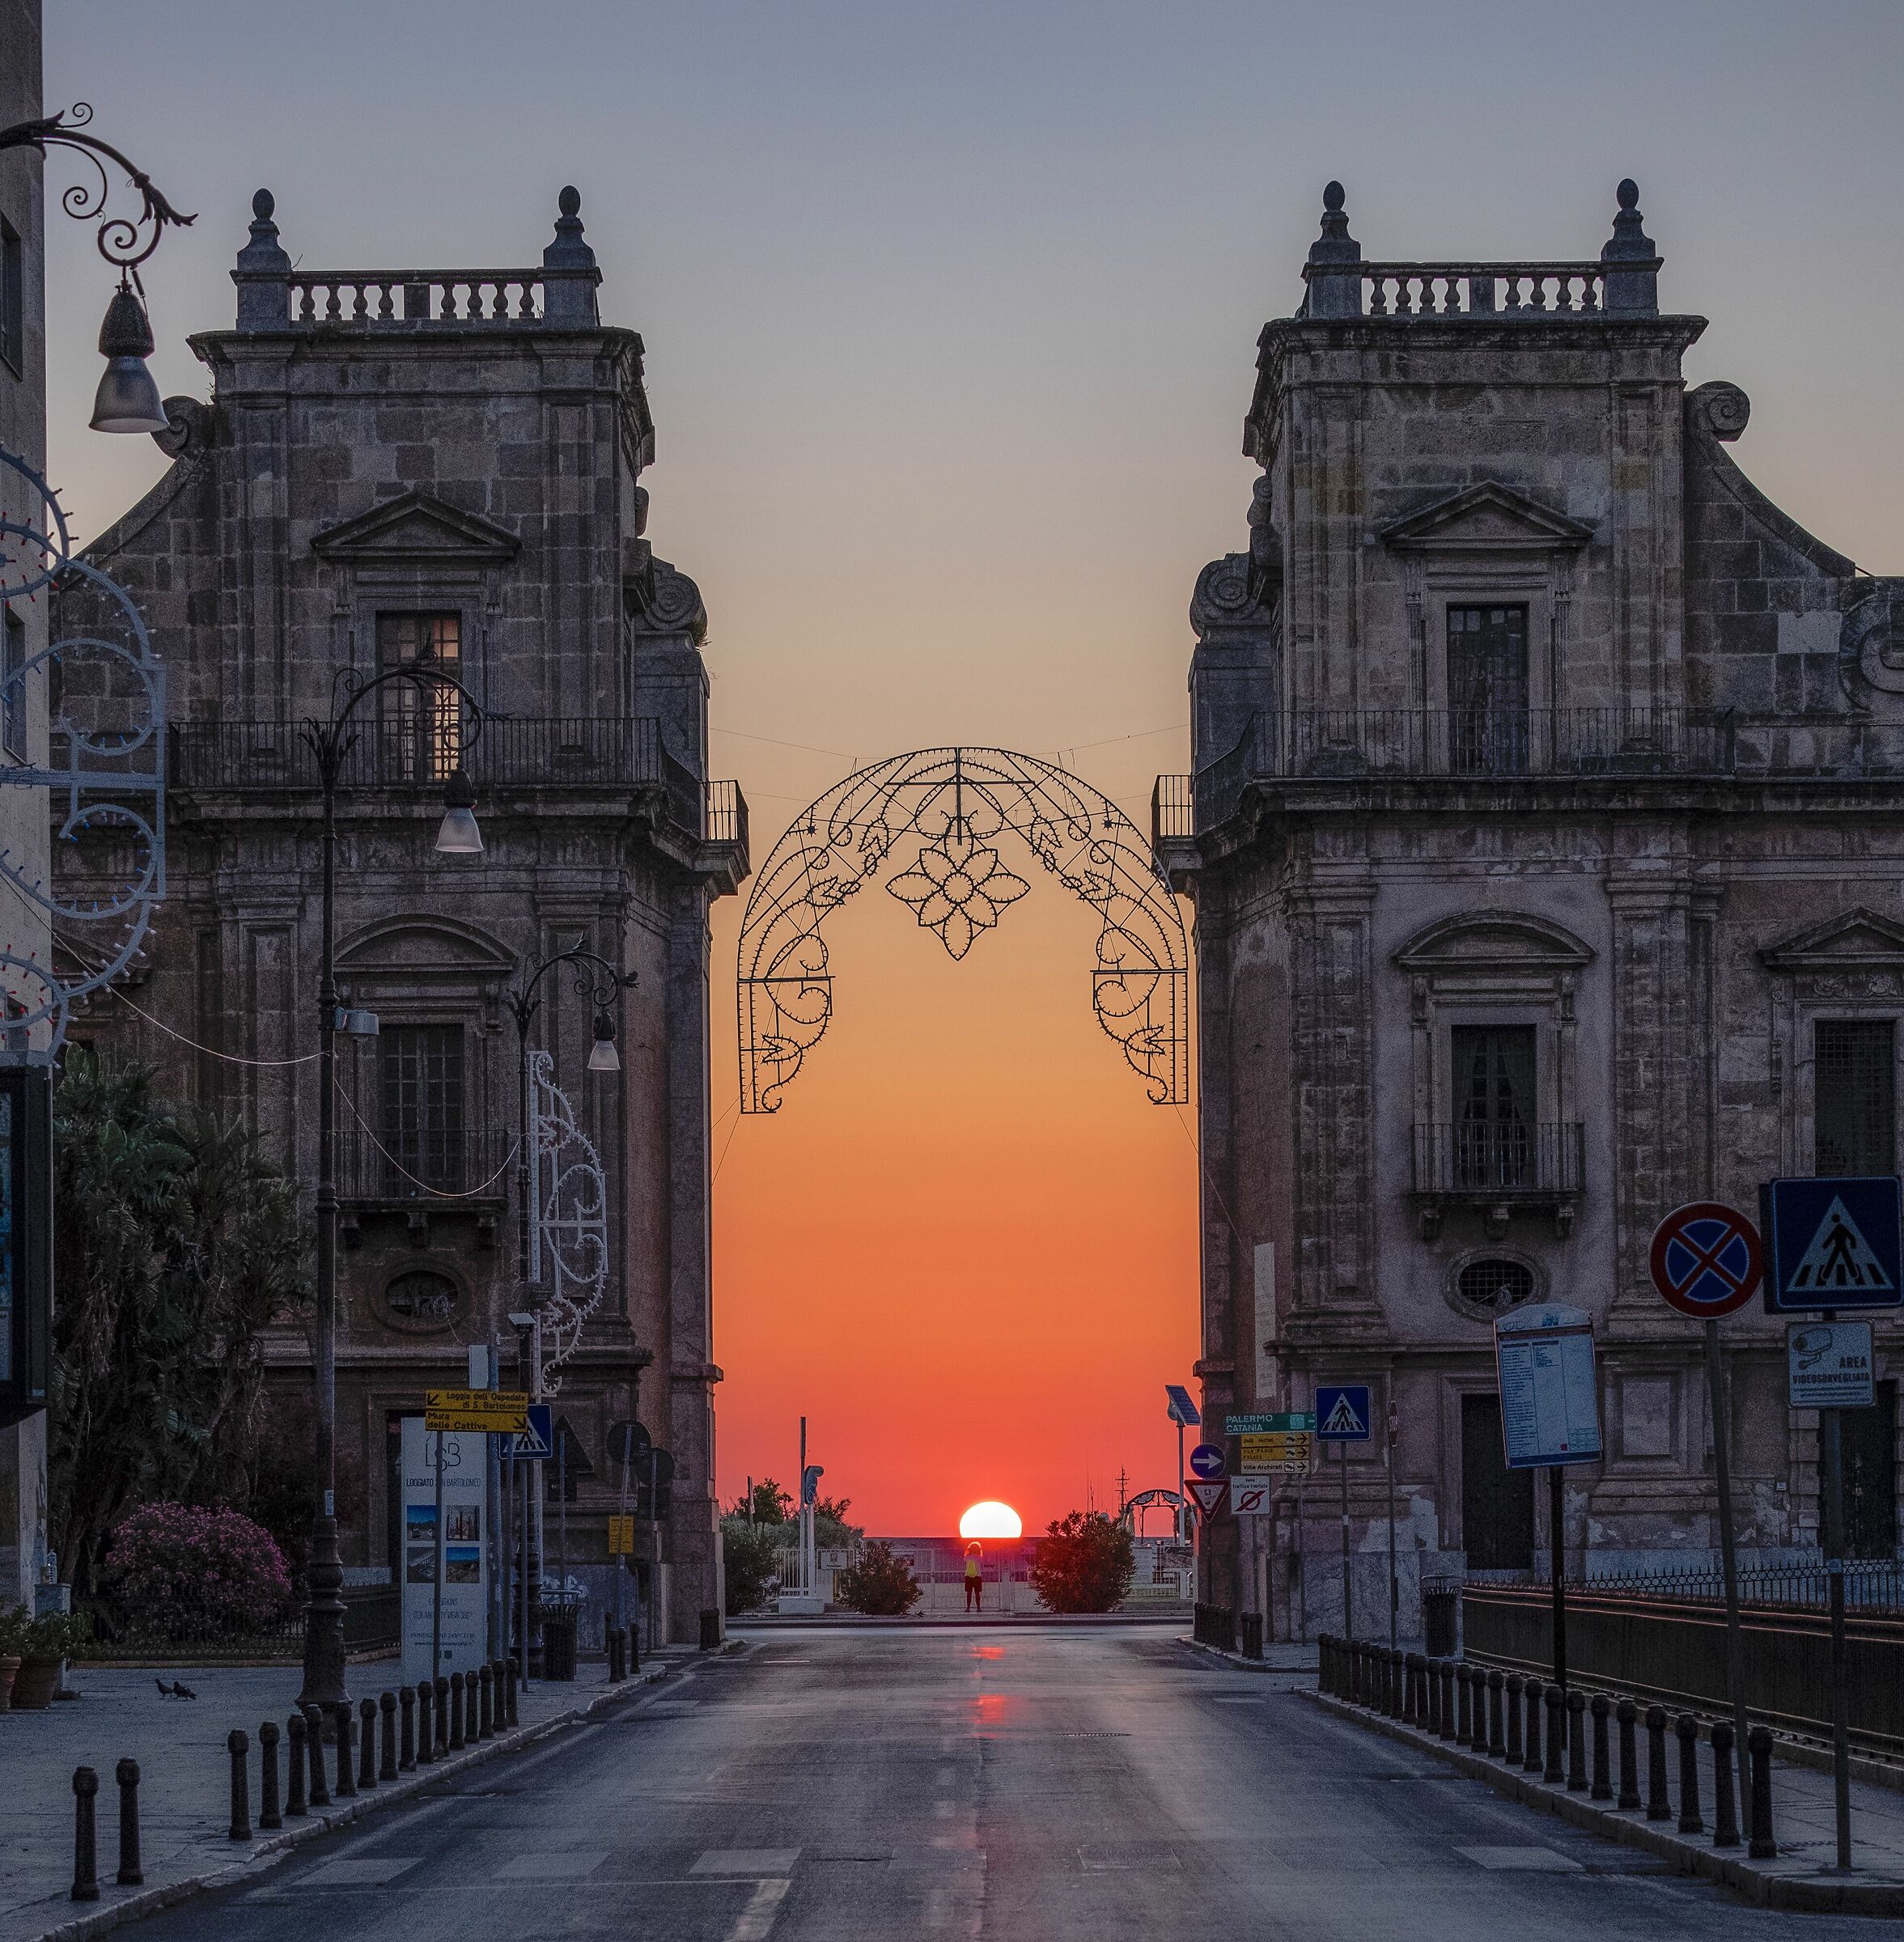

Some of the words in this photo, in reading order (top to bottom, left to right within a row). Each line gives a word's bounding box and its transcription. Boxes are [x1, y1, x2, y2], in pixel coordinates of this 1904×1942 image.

[1839, 1356, 1867, 1368] AREA
[1792, 1372, 1870, 1384] VIDEOSORVEGLIATA
[447, 1392, 470, 1401] Loggia
[428, 1412, 450, 1420] Mura
[1226, 1414, 1273, 1423] PALERMO
[428, 1421, 450, 1429] delle
[454, 1422, 488, 1430] Cattive
[1226, 1424, 1263, 1432] CATANIA
[406, 1478, 434, 1487] LOGGIATO
[447, 1478, 481, 1487] BARTOLOMEO
